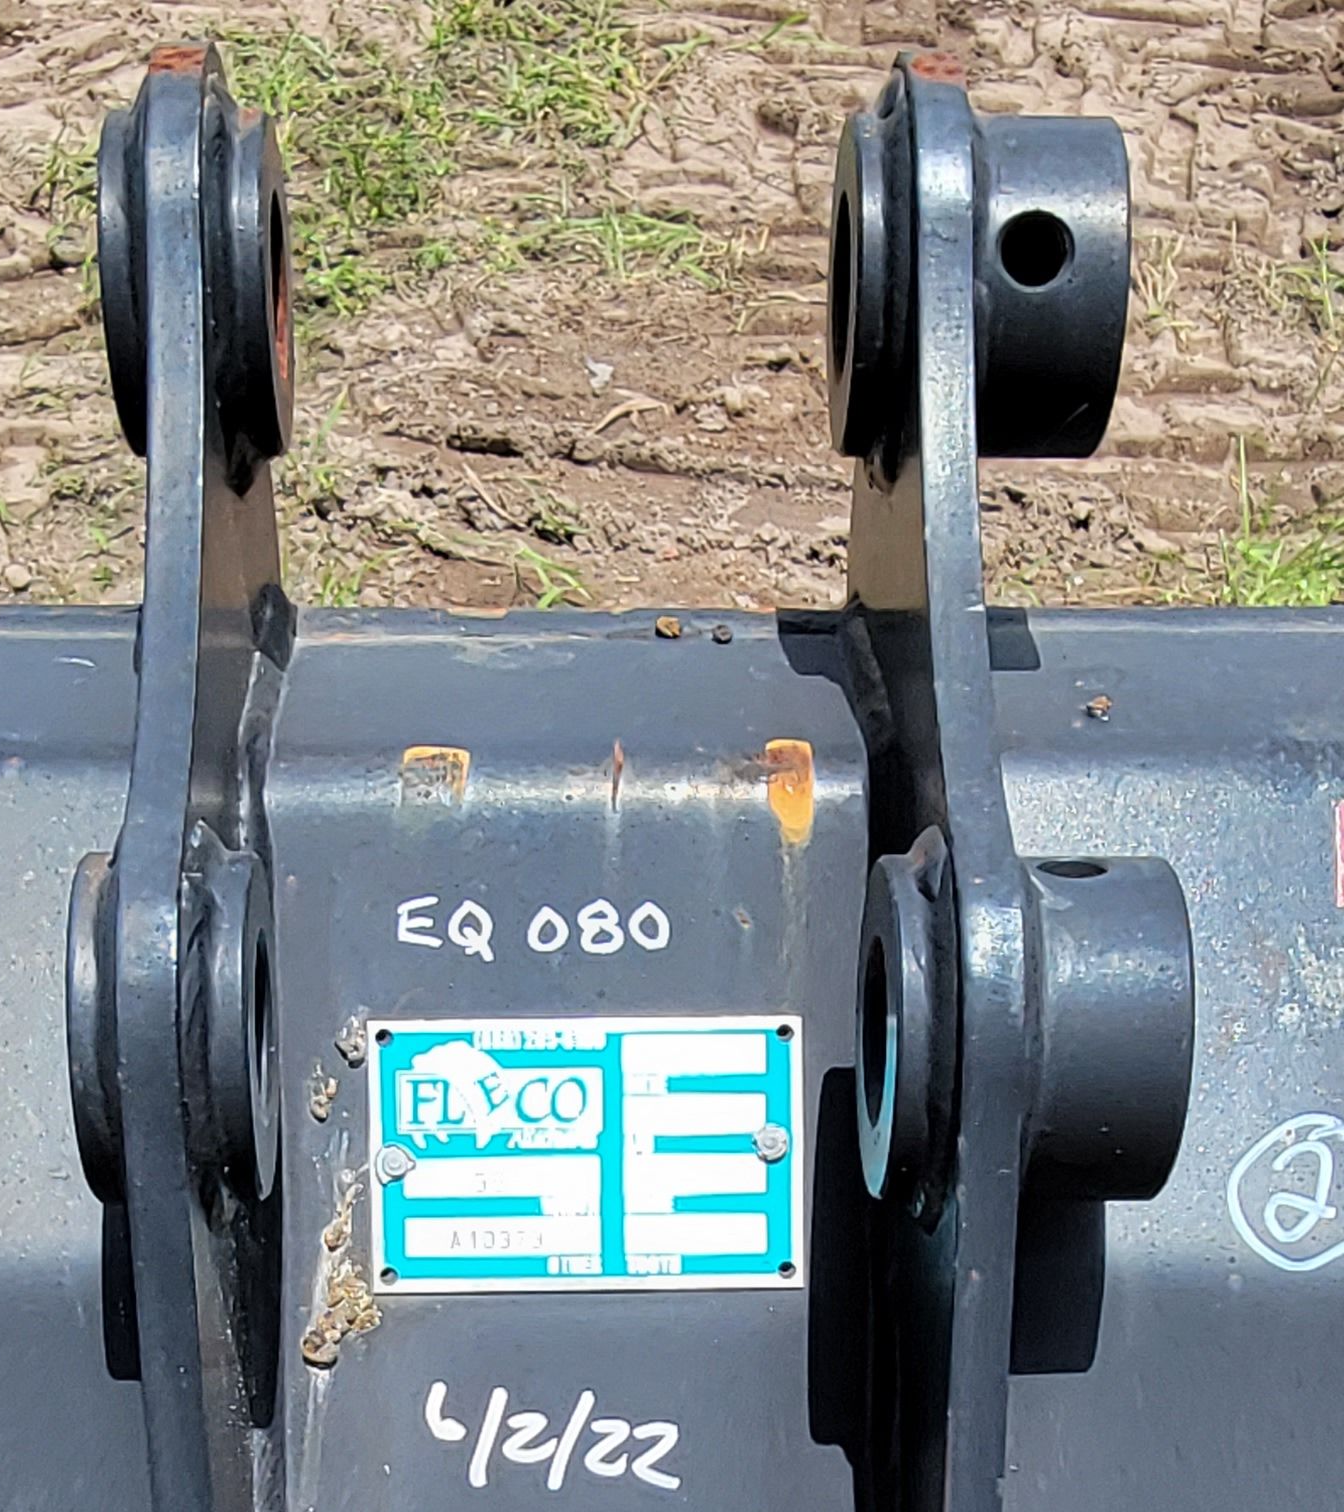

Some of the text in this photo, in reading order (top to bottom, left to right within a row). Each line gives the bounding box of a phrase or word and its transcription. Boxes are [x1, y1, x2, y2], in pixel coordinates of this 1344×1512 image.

[396, 895, 671, 962] EQ 080
[408, 1072, 588, 1126] FLECO
[425, 1380, 682, 1491] 6/2/22
